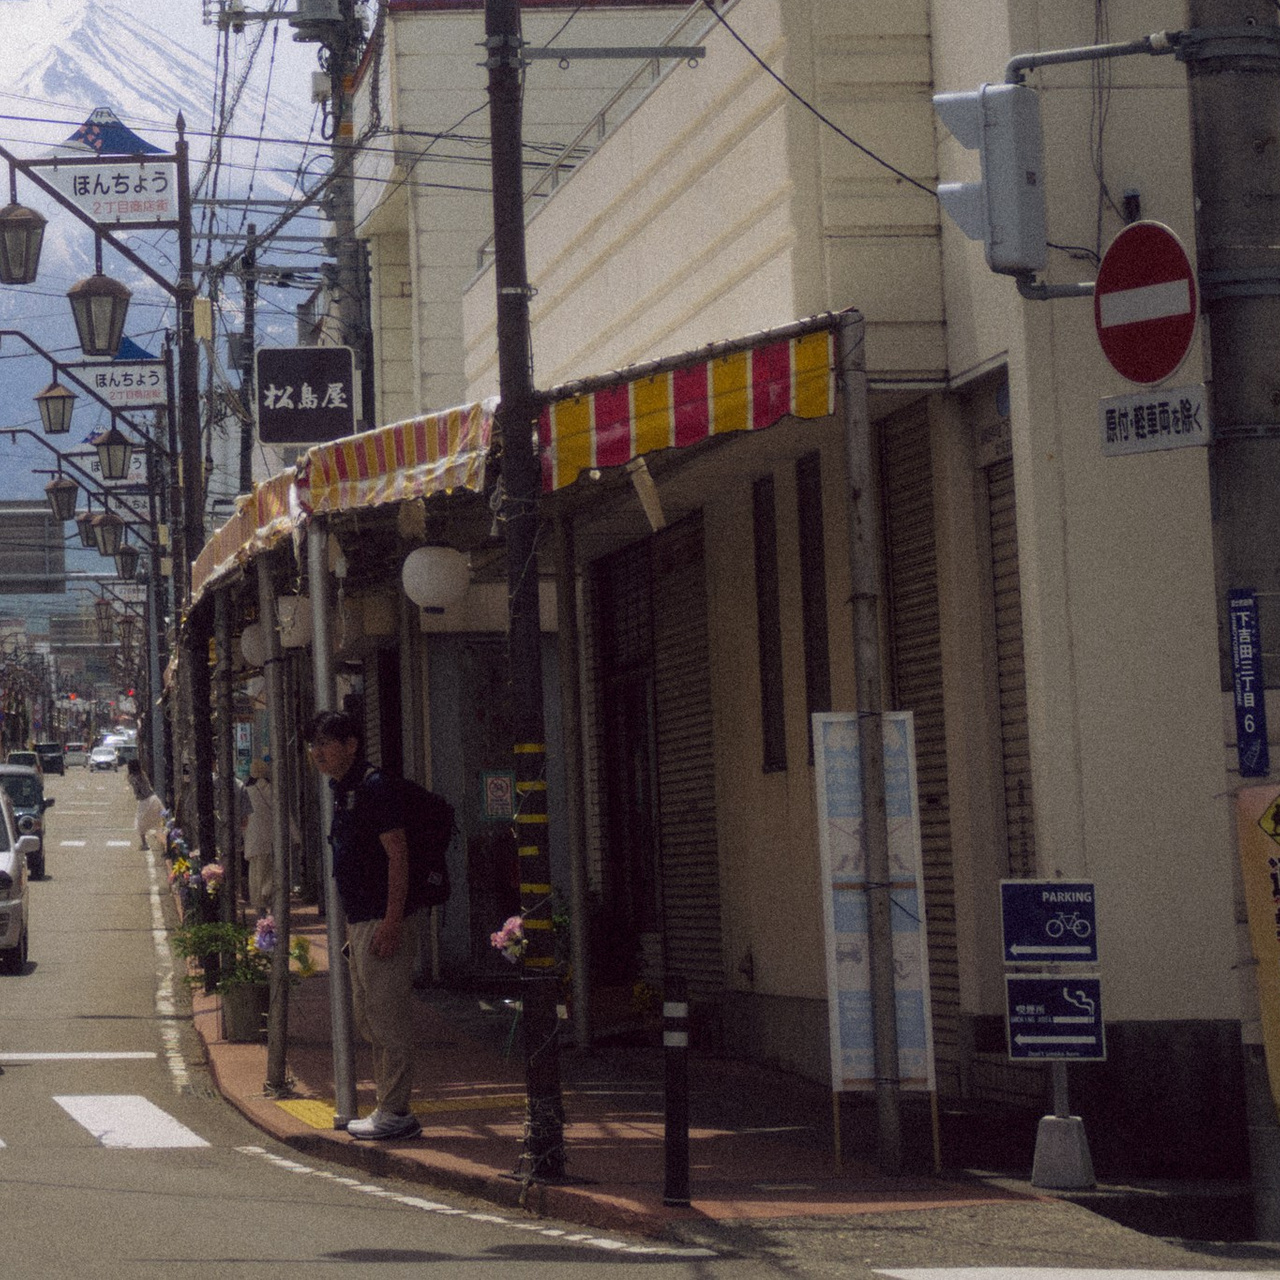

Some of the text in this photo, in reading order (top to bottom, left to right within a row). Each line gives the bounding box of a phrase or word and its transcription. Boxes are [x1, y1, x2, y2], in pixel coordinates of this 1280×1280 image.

[74, 171, 168, 197] ほんちょう
[96, 370, 160, 388] ほんちょう
[263, 382, 348, 410] 松島屋
[1237, 611, 1255, 708] 下吉田三丁目
[1244, 714, 1256, 733] 6
[1042, 892, 1092, 902] PARKING
